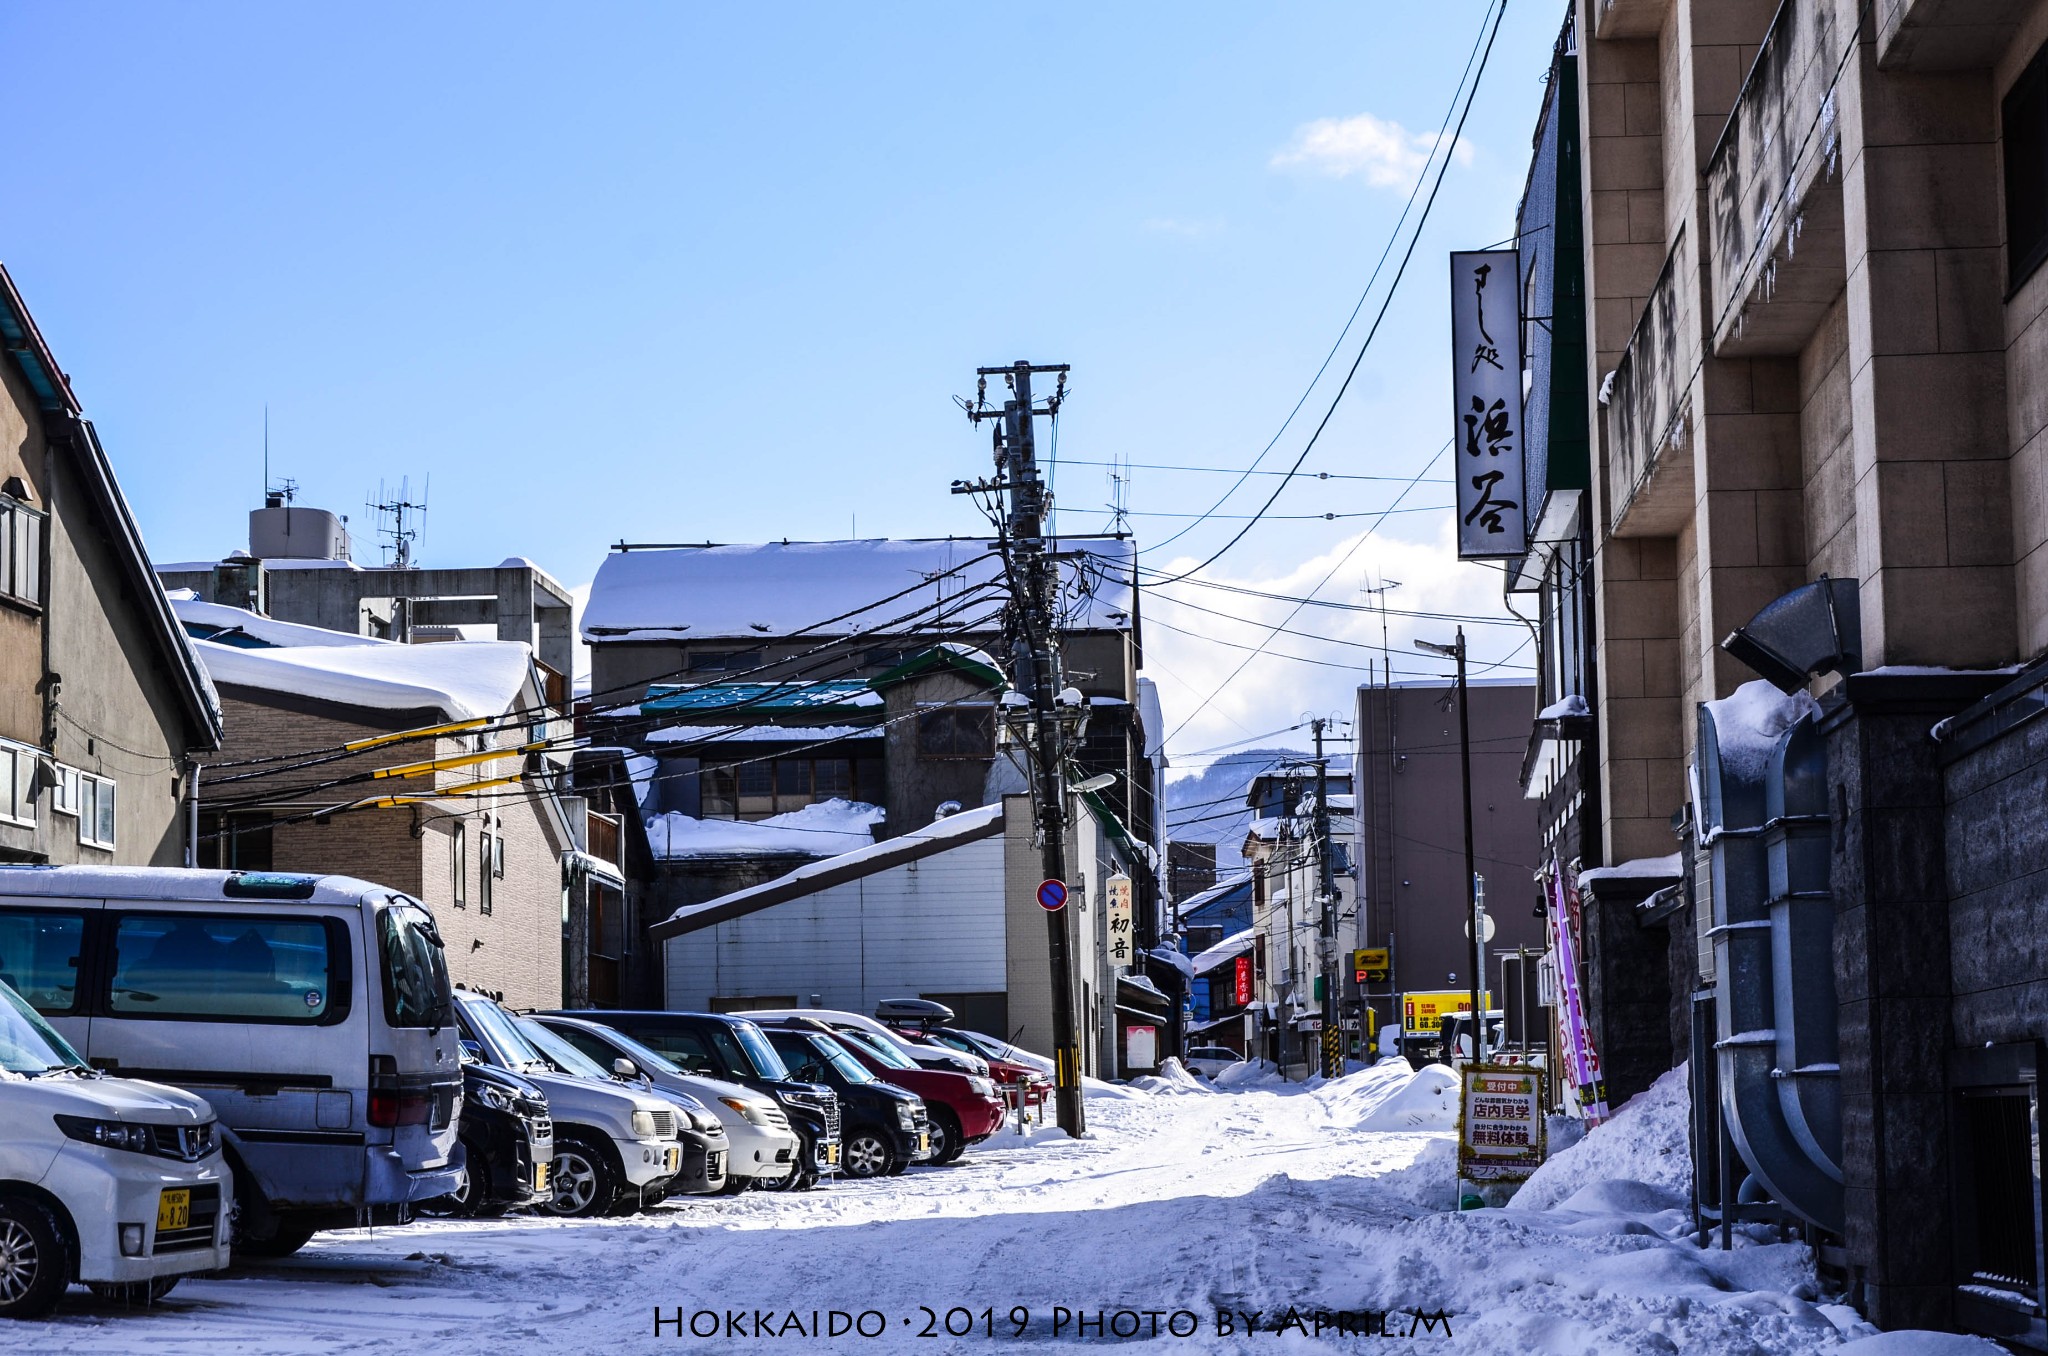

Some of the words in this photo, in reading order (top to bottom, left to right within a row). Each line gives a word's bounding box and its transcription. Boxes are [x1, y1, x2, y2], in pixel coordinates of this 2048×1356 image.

[1109, 912, 1130, 959] 初音
[1356, 970, 1368, 983] P
[1486, 1081, 1518, 1092] 受付中
[1473, 1104, 1530, 1119] 店内見学
[1472, 1131, 1529, 1146] 無料体験
